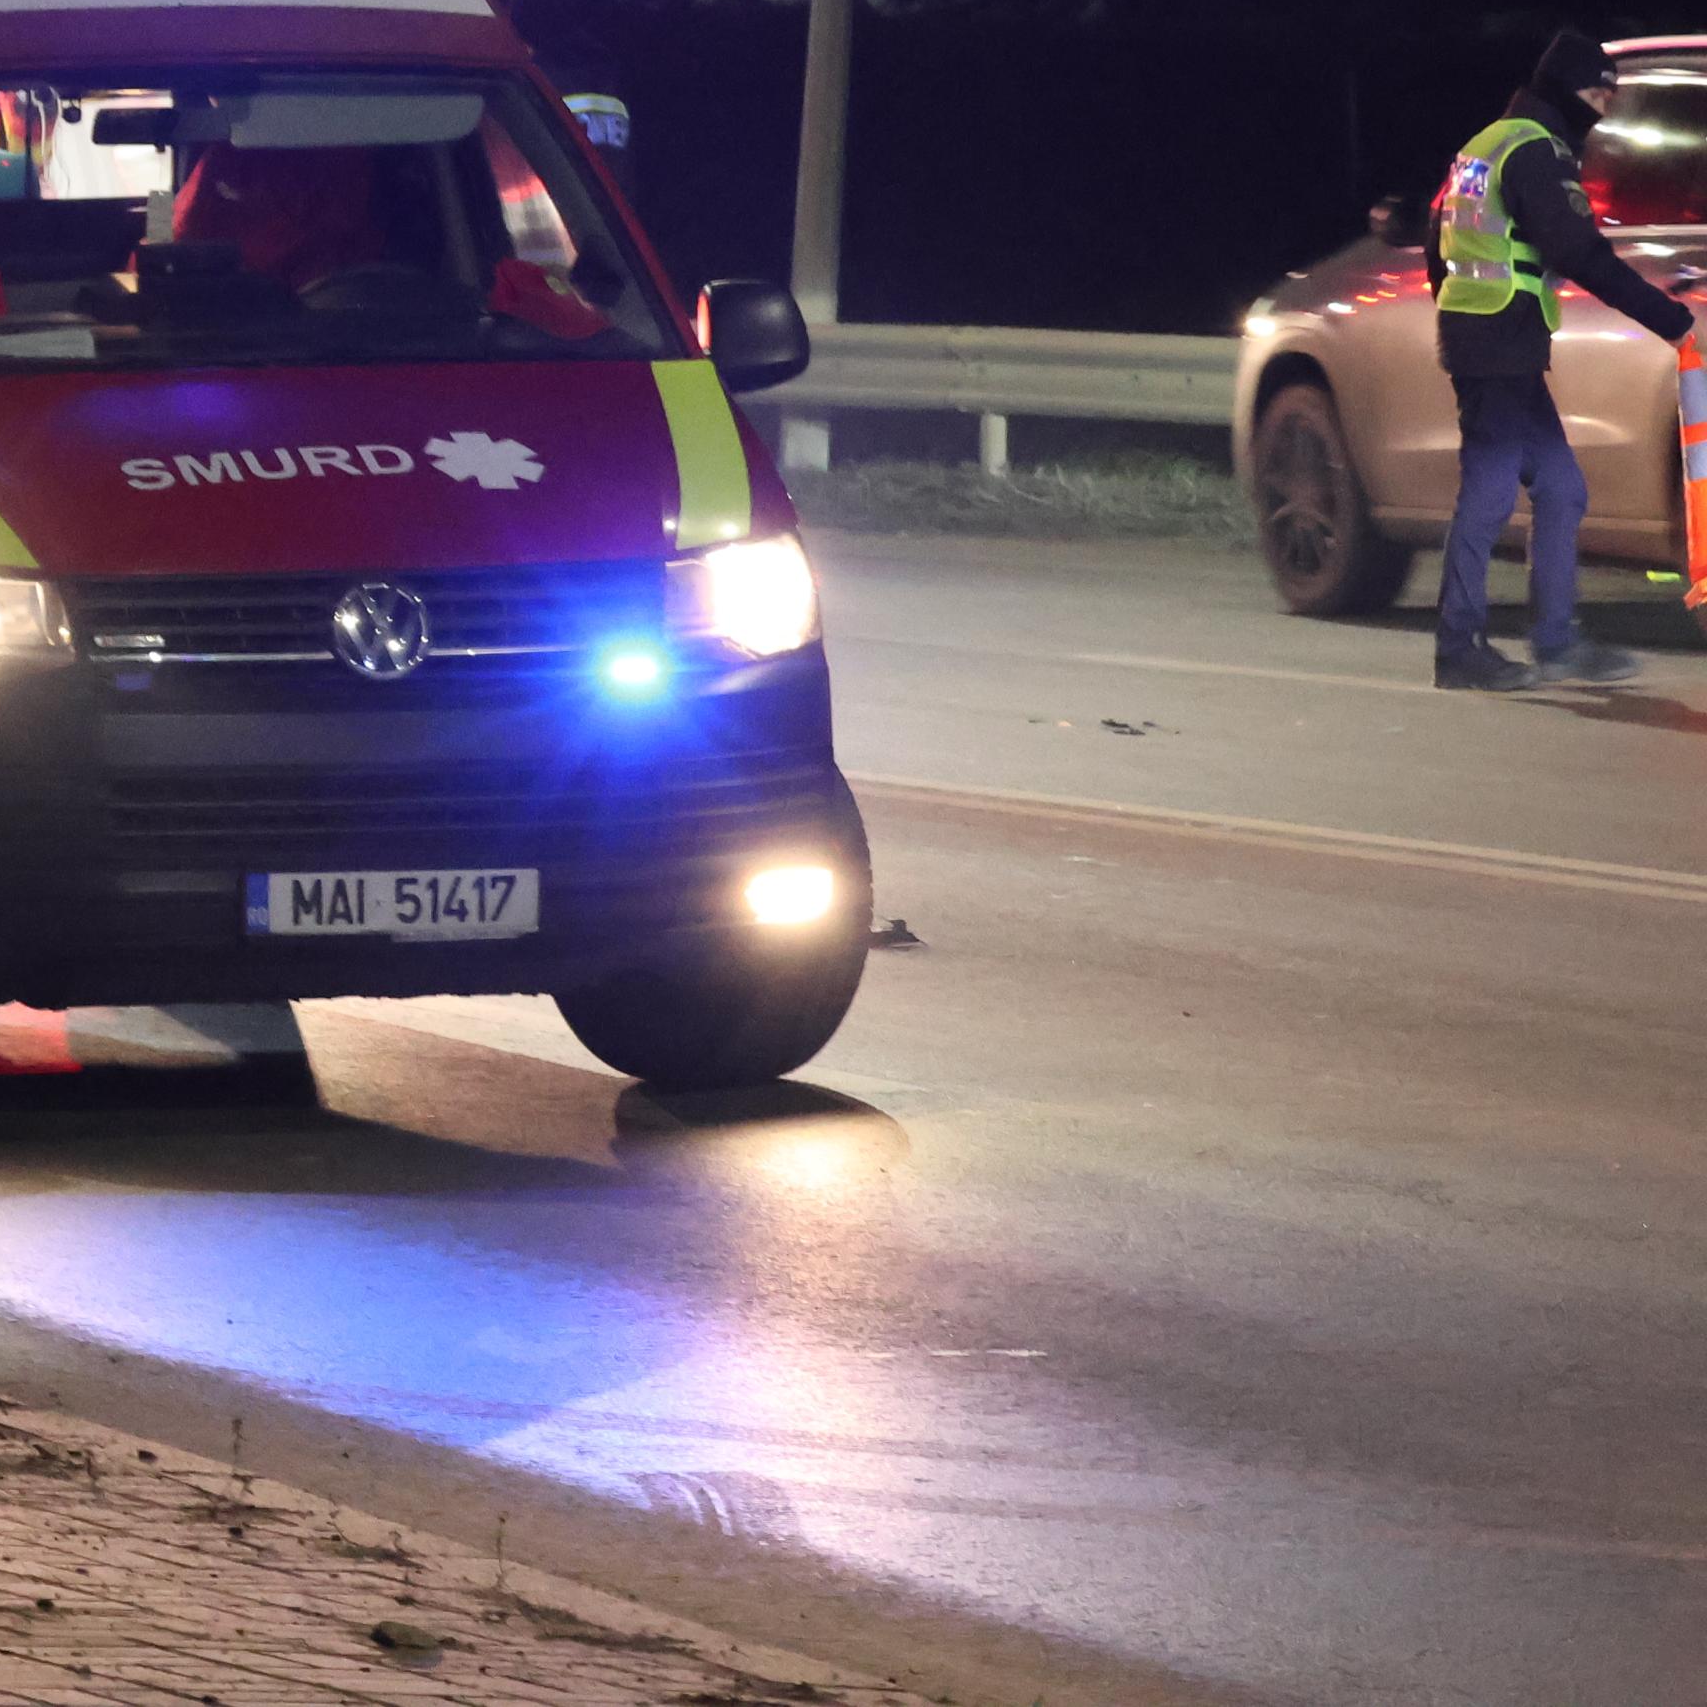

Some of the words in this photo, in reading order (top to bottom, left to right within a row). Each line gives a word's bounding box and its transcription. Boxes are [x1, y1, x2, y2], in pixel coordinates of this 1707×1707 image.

[120, 443, 416, 491] SMURD
[291, 878, 366, 926] MAI
[394, 875, 517, 924] 51417
